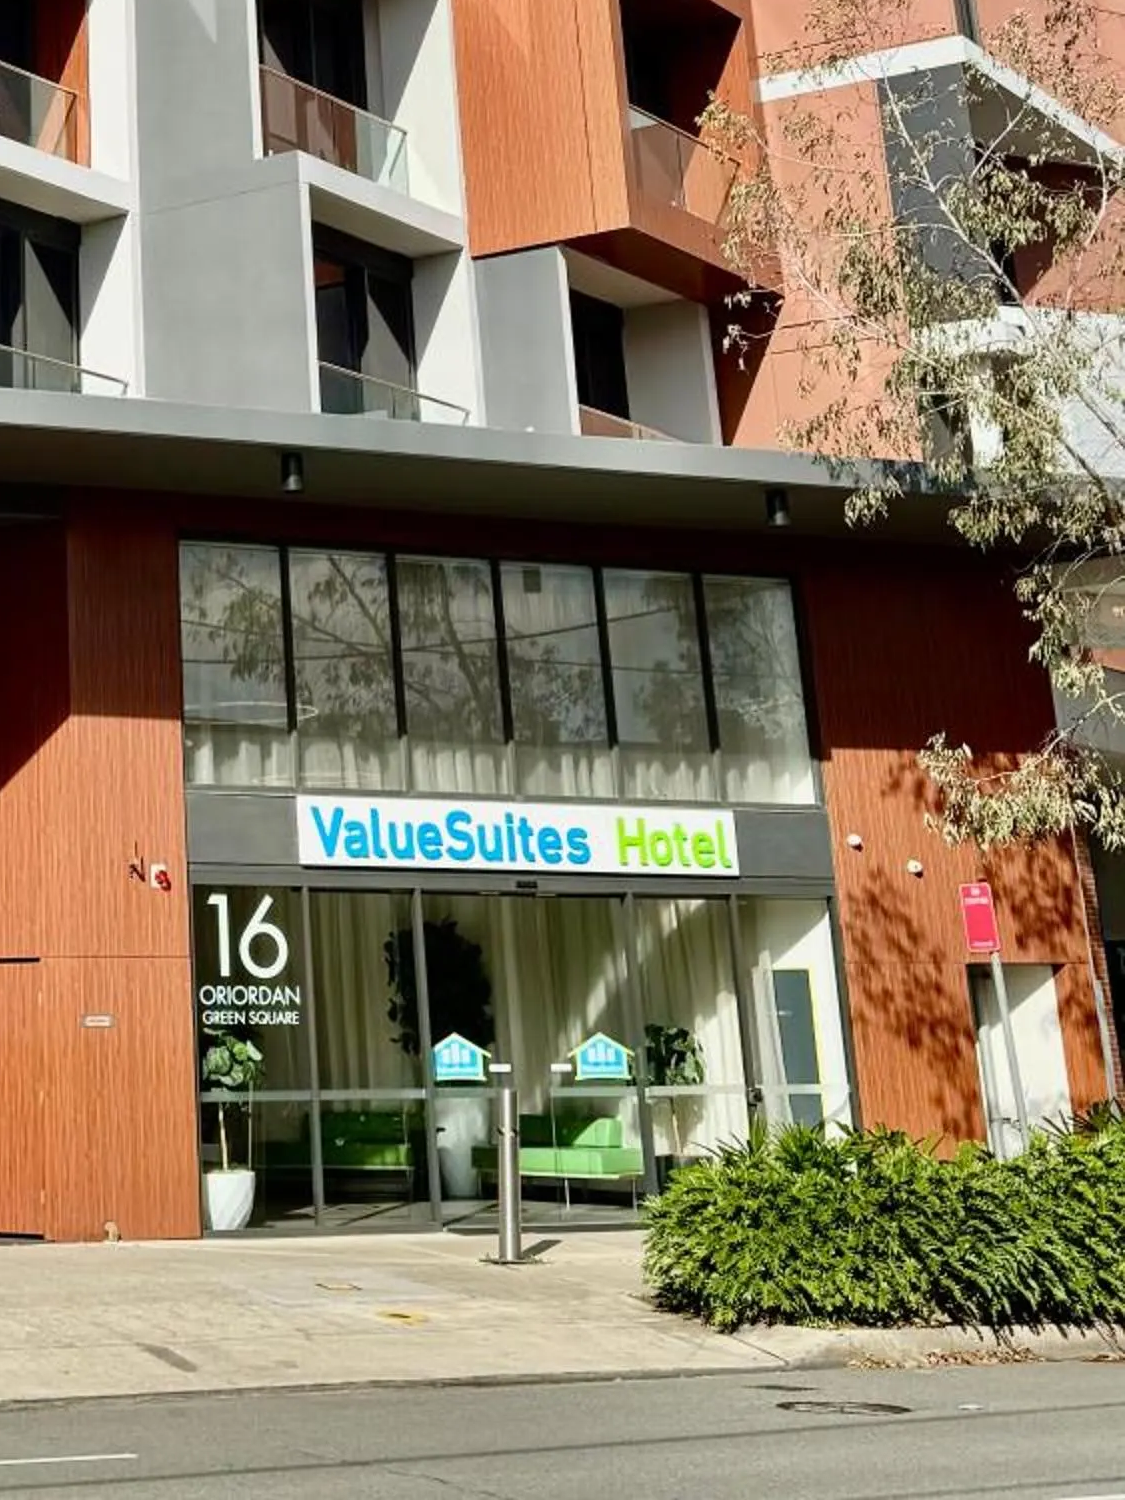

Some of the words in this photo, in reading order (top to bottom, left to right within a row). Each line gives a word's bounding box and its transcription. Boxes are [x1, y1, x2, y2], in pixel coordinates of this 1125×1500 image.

[311, 806, 592, 864] ValueSuites
[615, 817, 733, 869] Hotel
[207, 893, 288, 979] 16
[199, 985, 301, 1006] ORIORDAN
[202, 1010, 246, 1025] GREEN
[249, 1010, 300, 1025] SQUARE
